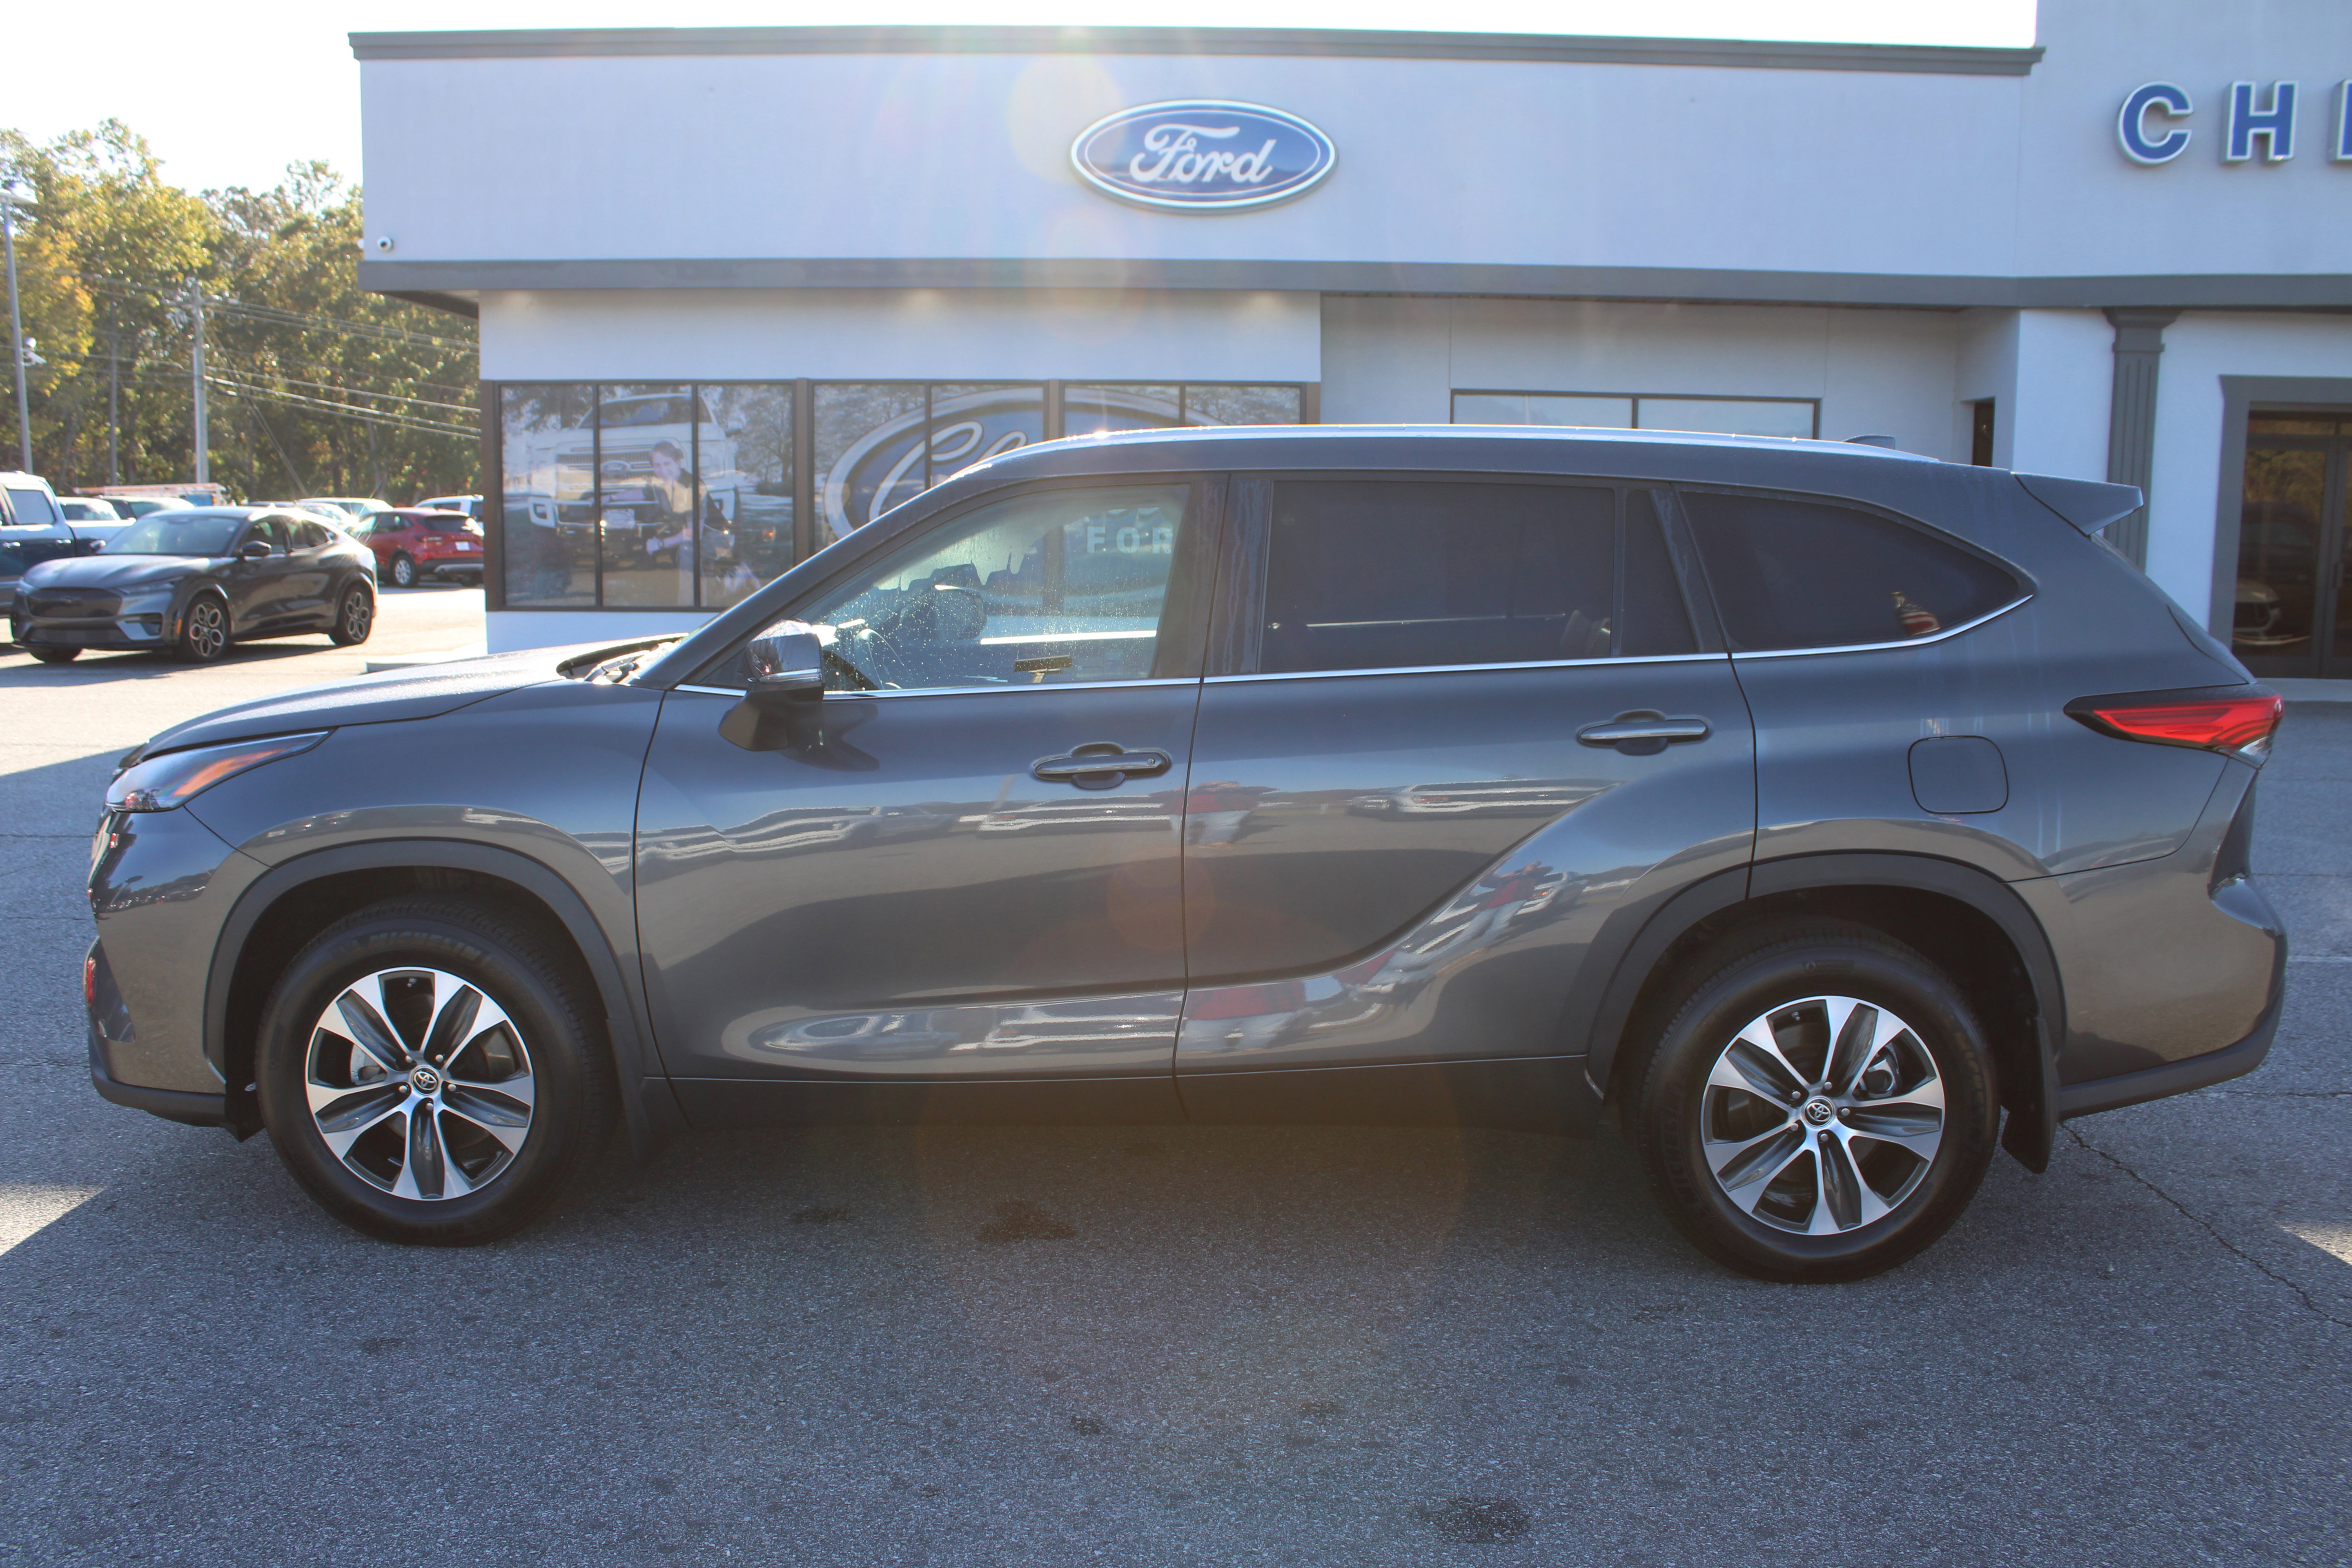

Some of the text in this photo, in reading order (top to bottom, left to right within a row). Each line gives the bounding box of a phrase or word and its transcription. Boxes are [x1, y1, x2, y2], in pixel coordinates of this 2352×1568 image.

[2118, 79, 2352, 165] CH
[1129, 123, 1277, 183] Ford
[369, 931, 482, 961] MICHELIN
